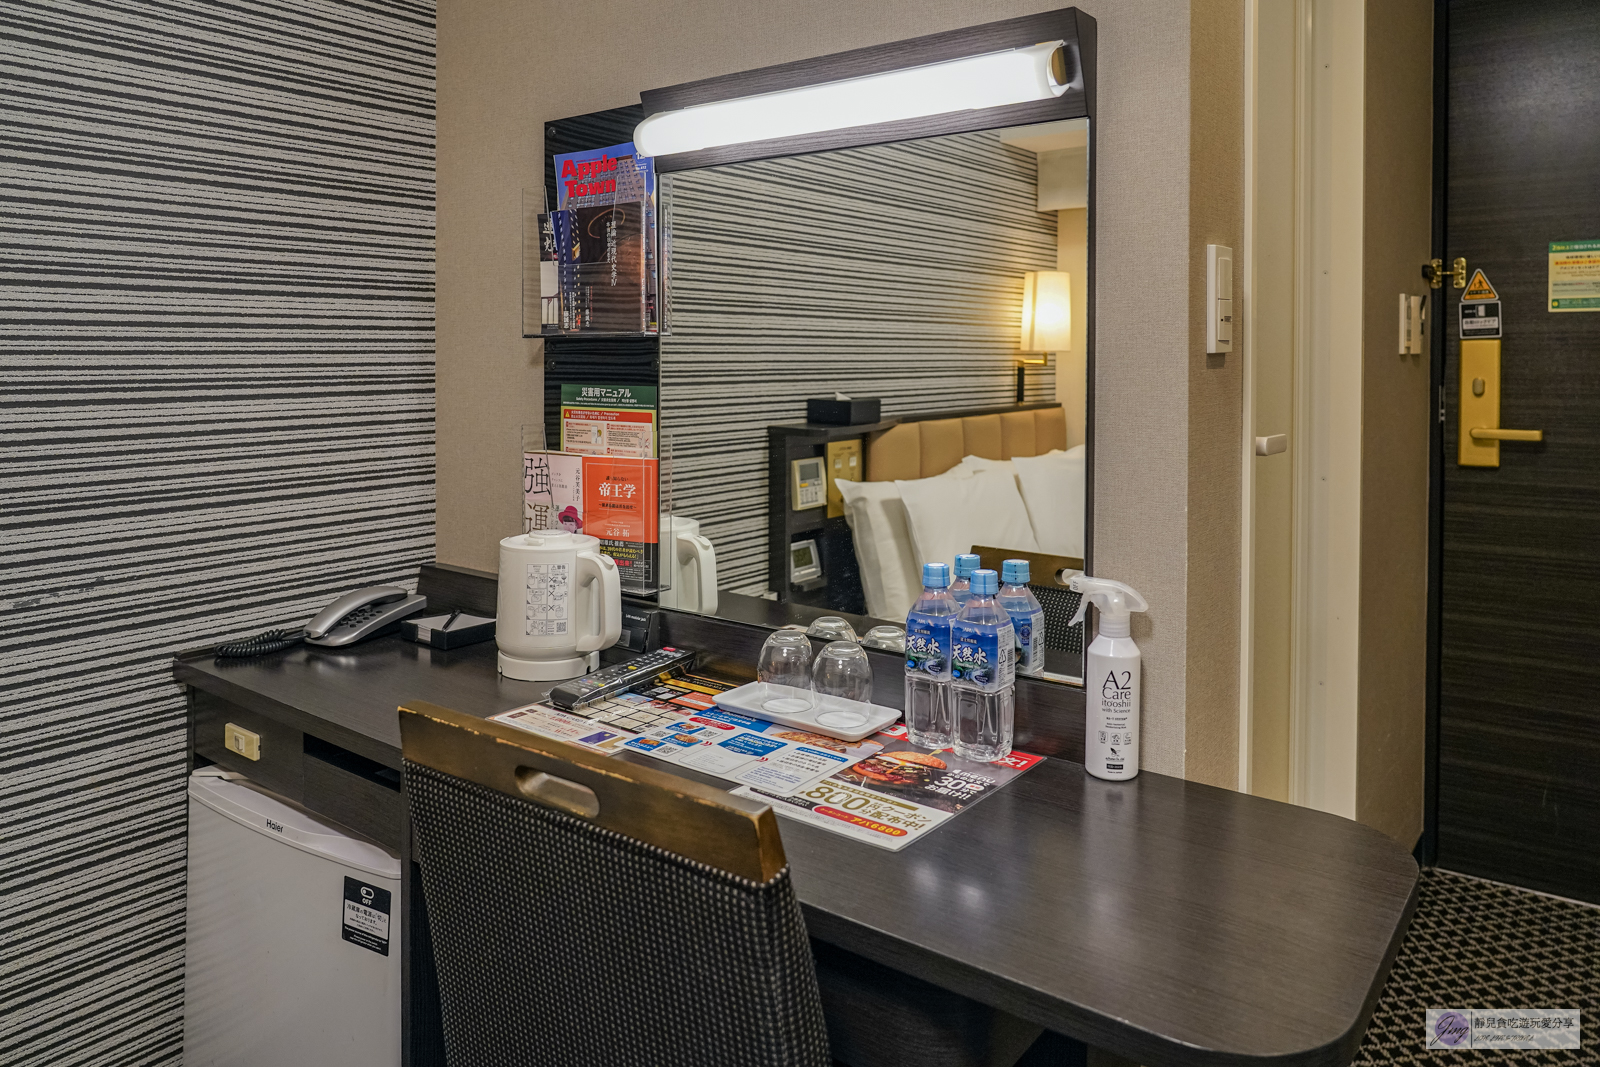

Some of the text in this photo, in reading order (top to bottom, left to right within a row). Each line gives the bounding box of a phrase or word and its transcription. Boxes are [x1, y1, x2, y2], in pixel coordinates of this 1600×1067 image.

[562, 154, 618, 180] Apple
[564, 179, 616, 198] Town
[582, 387, 632, 397] 災害用マニュアル
[599, 482, 636, 498] 帝王学
[606, 528, 620, 537] 元谷
[907, 635, 941, 655] 天然水
[953, 644, 987, 665] 天然水
[1103, 670, 1131, 690] A2
[1102, 687, 1131, 700] Care
[934, 777, 966, 789] 30
[960, 772, 995, 783] menu
[798, 786, 871, 810] ,800
[924, 784, 972, 800] お届け!!
[858, 808, 926, 830] 分配布中!
[869, 802, 932, 822] 円クーポン
[266, 819, 283, 833] Haier
[850, 816, 901, 835] アパ6800
